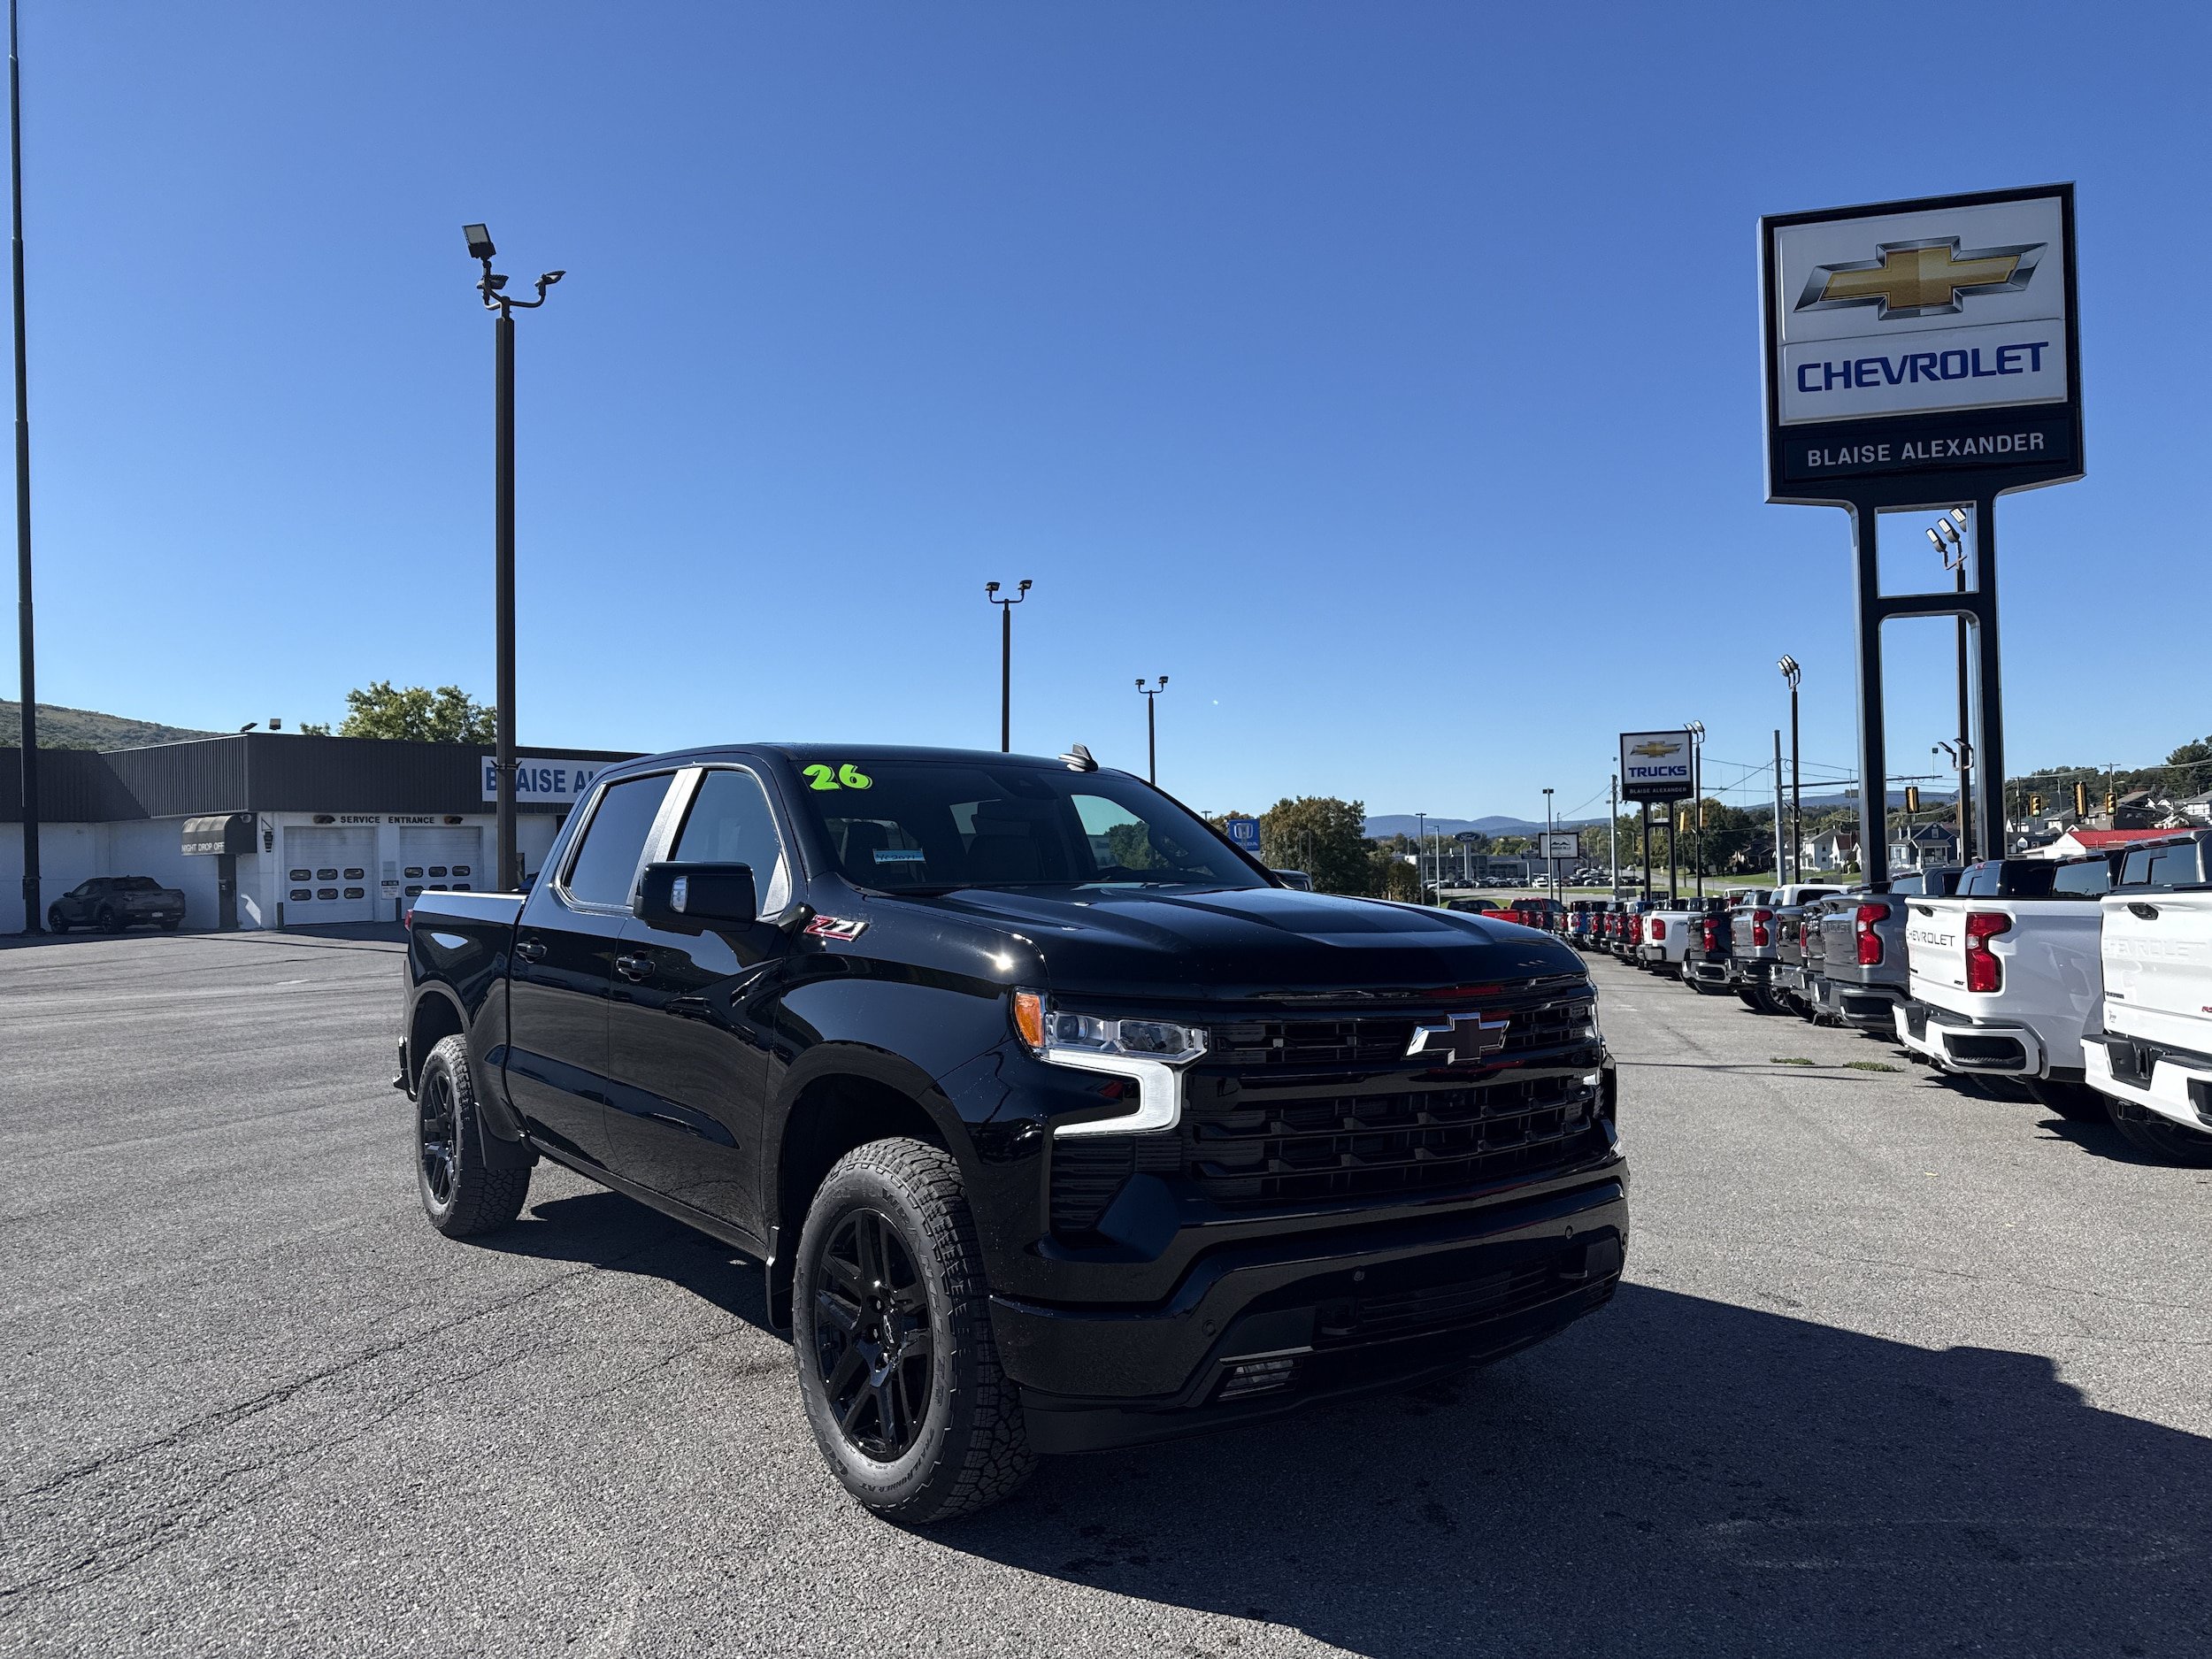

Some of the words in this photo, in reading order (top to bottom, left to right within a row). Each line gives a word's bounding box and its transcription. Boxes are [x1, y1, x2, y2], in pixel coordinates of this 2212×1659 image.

[1797, 342, 2049, 393] CHEVROLET
[1808, 443, 1891, 467] BLAISE
[1901, 432, 2045, 460] ALEXANDER
[486, 767, 566, 793] BAISE
[803, 764, 873, 790] 26
[1628, 765, 1686, 778] TRUCKS
[181, 843, 197, 852] NIGHT
[198, 842, 212, 852] DROP
[213, 841, 225, 850] OFF
[803, 914, 871, 942] Z71
